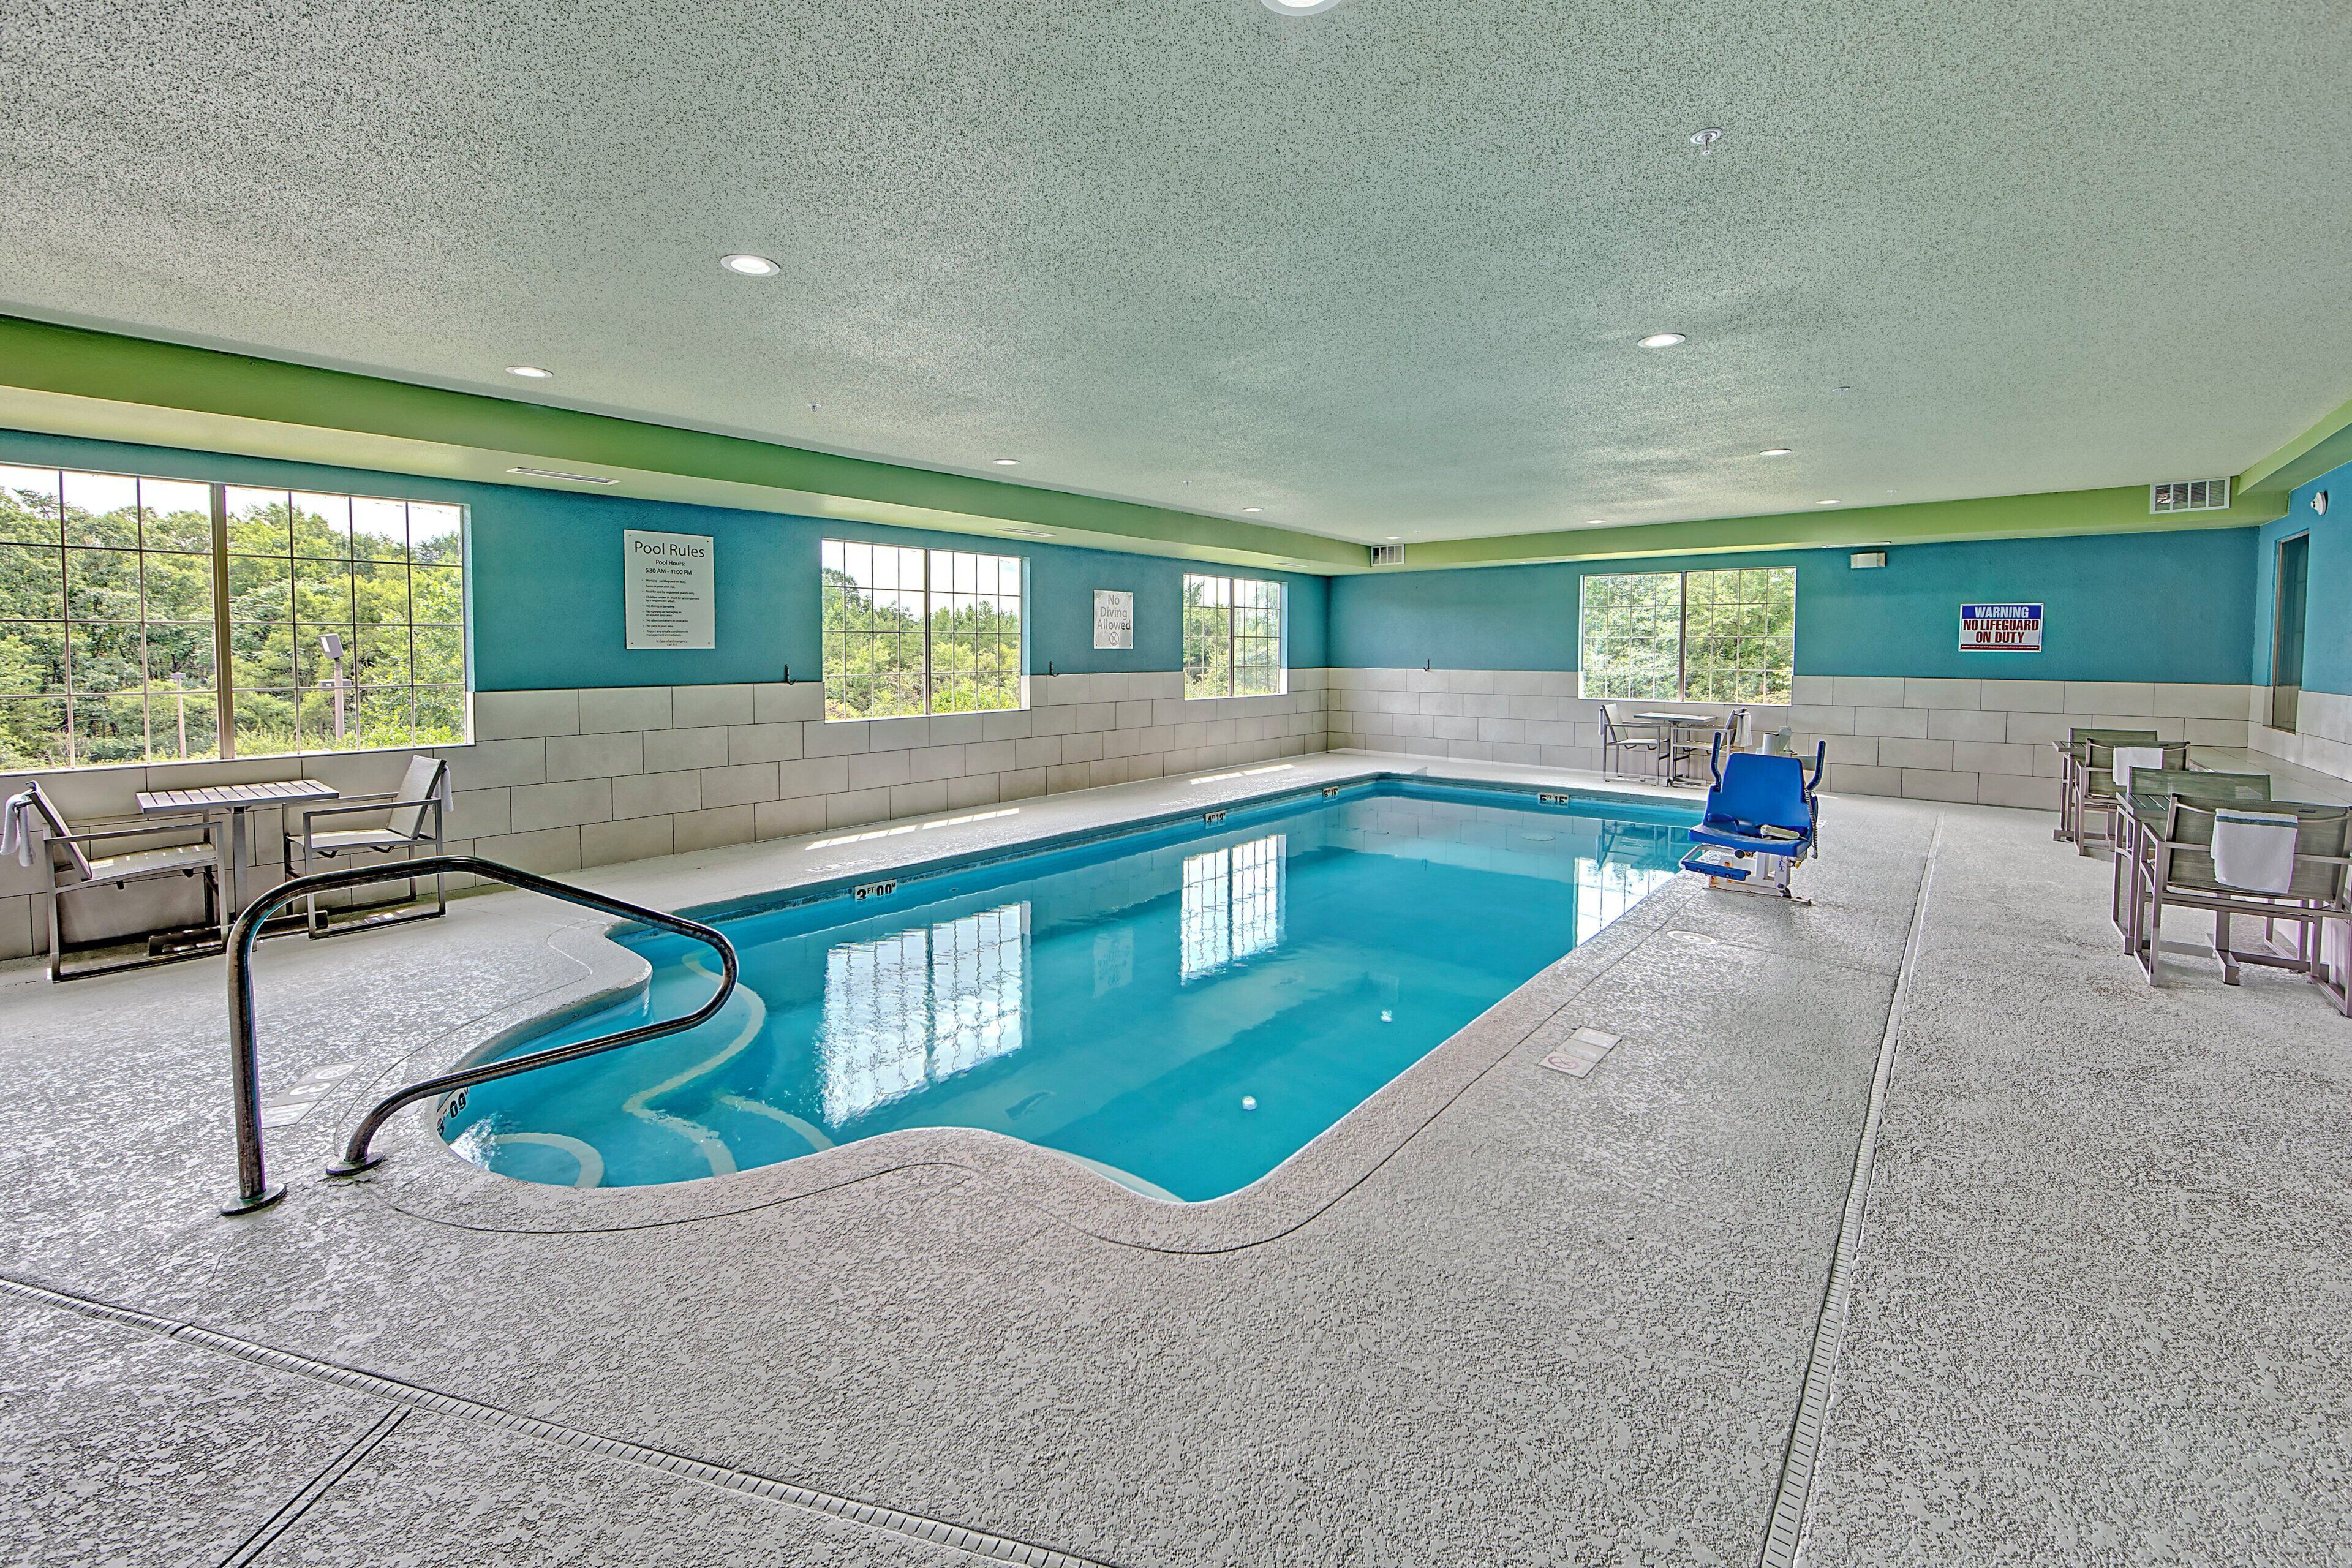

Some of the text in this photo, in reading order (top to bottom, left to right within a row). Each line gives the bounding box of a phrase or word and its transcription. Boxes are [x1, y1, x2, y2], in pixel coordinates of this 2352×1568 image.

[635, 541, 704, 557] Pool Rules
[1108, 595, 1119, 605] No
[1101, 607, 1127, 620] Diving
[1975, 606, 2029, 618] WARNING
[1097, 619, 1130, 630] Allowed
[1964, 620, 2038, 631] NO LIFEGUARD
[1976, 632, 2024, 643] ON DUTY
